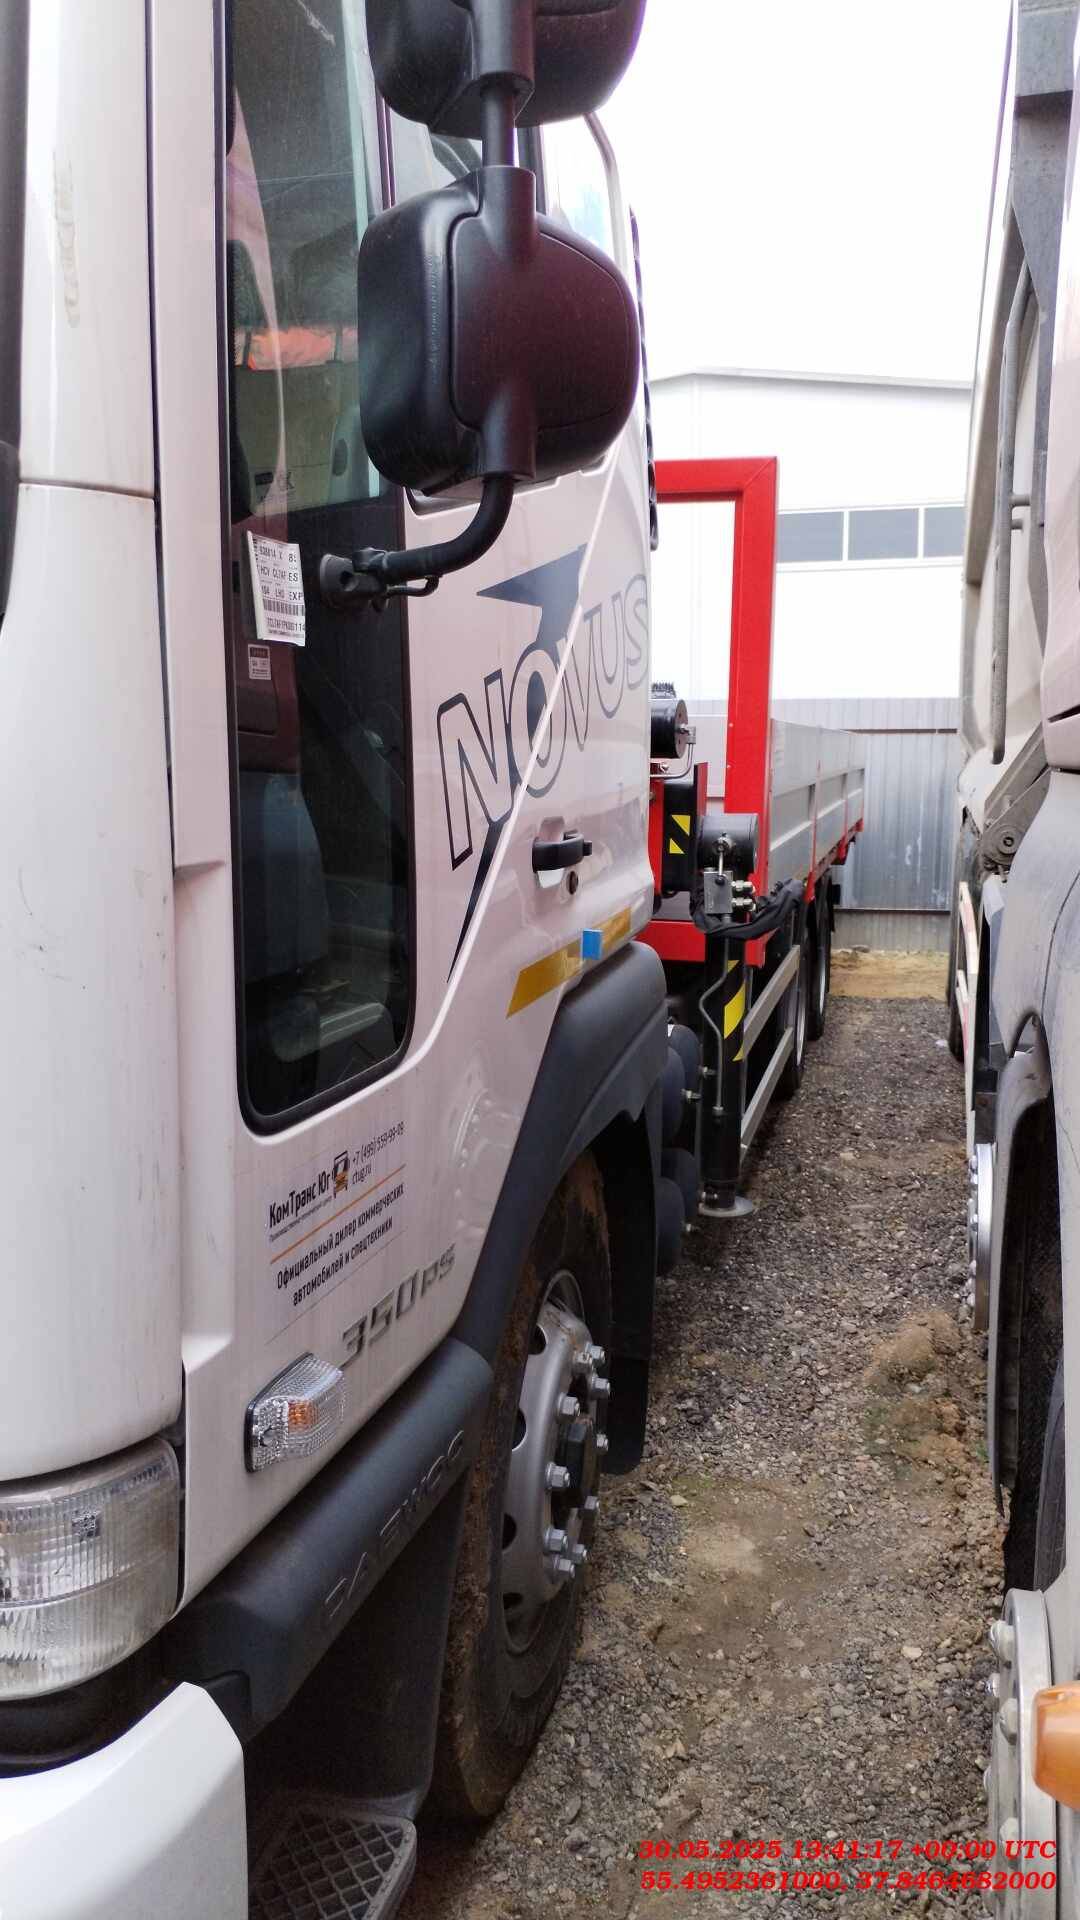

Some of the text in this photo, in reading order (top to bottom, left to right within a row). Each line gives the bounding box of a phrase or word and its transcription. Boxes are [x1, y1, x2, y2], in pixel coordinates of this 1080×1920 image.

[437, 574, 649, 871] NOVUS
[269, 1184, 317, 1229] КомТранс
[318, 1170, 332, 1197] Юг
[277, 1232, 335, 1290] Официальный
[334, 1220, 357, 1248] дилер
[357, 1182, 405, 1230] коммерческих
[293, 1253, 344, 1307] автомобилей
[350, 1216, 393, 1262] спецтехники
